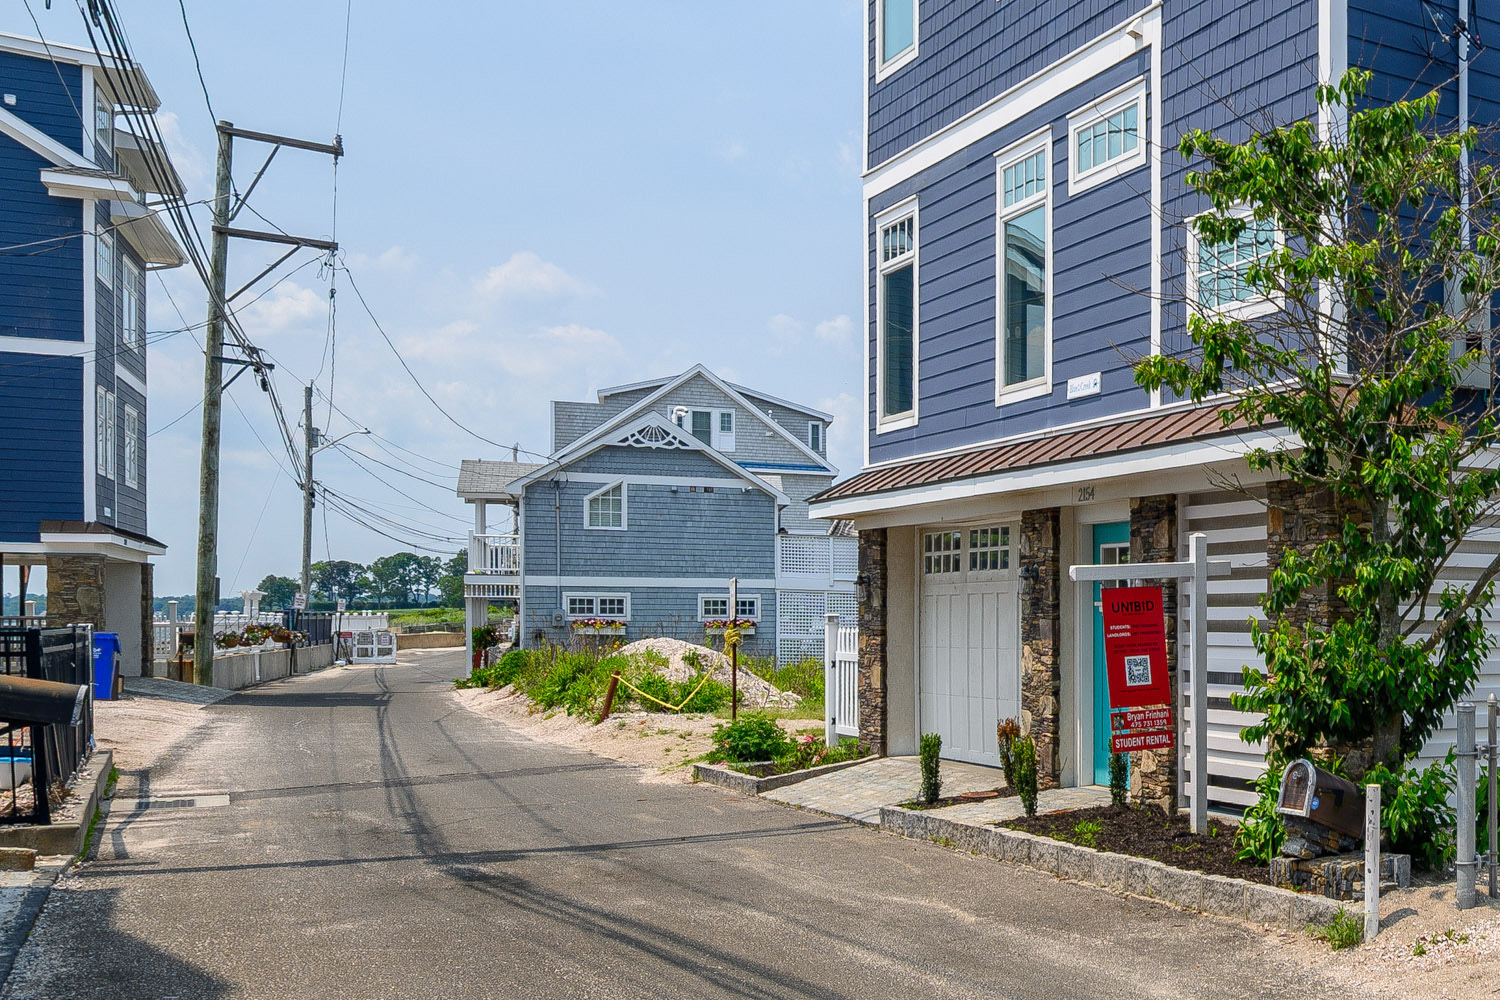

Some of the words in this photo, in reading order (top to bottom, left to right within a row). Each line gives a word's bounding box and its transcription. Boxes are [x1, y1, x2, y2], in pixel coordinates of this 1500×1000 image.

[1078, 486, 1095, 502] 2154
[1127, 712, 1144, 722] Bryan
[1115, 736, 1145, 749] STUDENT
[1145, 734, 1171, 746] RENTAL
